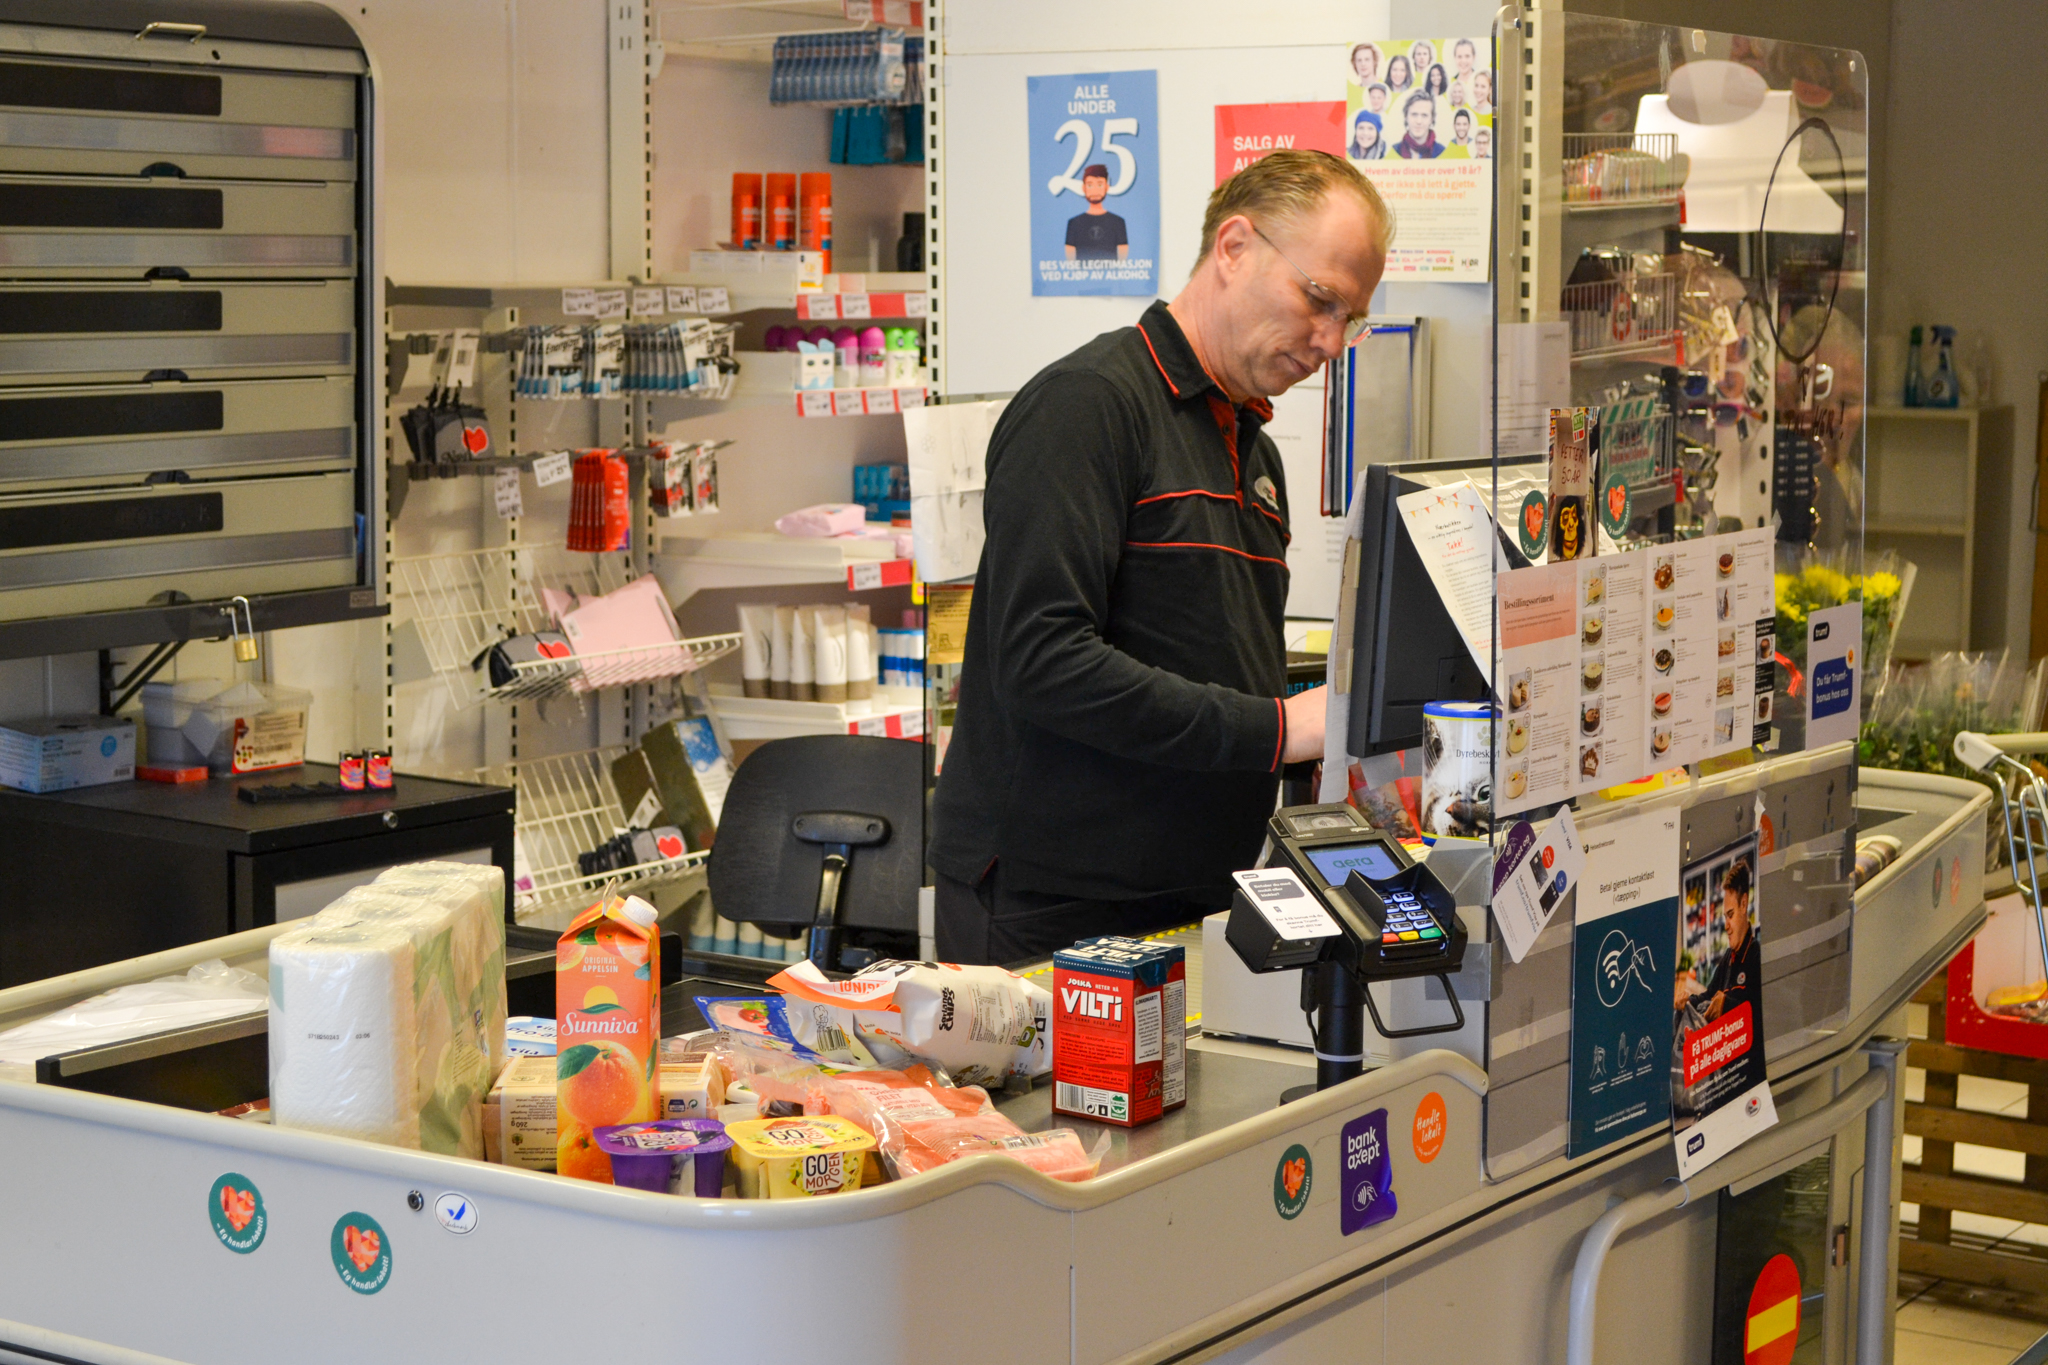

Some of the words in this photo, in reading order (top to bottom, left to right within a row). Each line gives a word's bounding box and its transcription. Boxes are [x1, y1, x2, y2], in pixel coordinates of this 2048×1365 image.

[1074, 85, 1109, 100] ALLE
[1068, 100, 1116, 115] UNDER
[1233, 135, 1272, 151] SALG
[1275, 135, 1295, 149] AV
[1048, 117, 1139, 198] 25
[1365, 167, 1389, 176] Hvem
[1403, 166, 1425, 175] disse
[1427, 167, 1435, 175] er
[1437, 167, 1455, 175] over
[1458, 166, 1467, 175] 18
[1469, 165, 1481, 174] år?
[1396, 179, 1414, 188] ikke
[1416, 179, 1426, 188] så
[1428, 179, 1442, 188] lett
[1444, 179, 1450, 188] å
[1451, 180, 1477, 190] gjette.
[1381, 190, 1408, 199] Derfor
[1410, 189, 1422, 199] må
[1424, 189, 1435, 199] du
[1437, 191, 1467, 201] spørre!
[1040, 261, 1057, 270] BES
[1060, 260, 1081, 270] VISE
[1083, 259, 1153, 270] LEGITIMASJON
[1041, 271, 1061, 281] VED
[1063, 270, 1088, 281] KJØP
[1090, 270, 1104, 280] AV
[1106, 270, 1150, 280] ALKOHOL
[1816, 677, 1824, 687] Du
[1824, 674, 1832, 685] får
[1832, 671, 1848, 684] Trumf-
[1816, 692, 1831, 704] bonus
[1831, 689, 1840, 700] hos
[1841, 688, 1849, 698] oss
[1332, 855, 1374, 869] aera
[1600, 881, 1612, 893] Betal
[1613, 879, 1627, 892] gjerne
[1628, 871, 1655, 885] kontaktløst
[582, 964, 619, 973] APPELSIN
[584, 956, 616, 965] ORIGINAL
[1067, 978, 1092, 989] JOIKA
[944, 989, 955, 1031] CHIPS
[561, 1012, 639, 1036] Sunniva
[1692, 1037, 1701, 1057] Få
[1700, 1017, 1744, 1048] TRUMF-bonus
[1690, 1058, 1699, 1080] på
[1699, 1053, 1712, 1070] alle
[1711, 1032, 1748, 1064] dagligvarer
[1417, 1109, 1440, 1131] Handle
[768, 1128, 805, 1140] GO
[1348, 1126, 1377, 1153] bank
[1421, 1121, 1441, 1144] lokalt
[1347, 1141, 1380, 1170] axept
[805, 1154, 828, 1177] GO
[805, 1151, 841, 1190] MORGEN
[1280, 1201, 1286, 1214] Eg
[1285, 1202, 1302, 1215] handlar
[219, 1228, 228, 1240] Eg
[228, 1236, 253, 1248] handlar
[252, 1216, 264, 1243] lokalt!
[342, 1269, 352, 1281] Eg
[351, 1278, 378, 1290] handlar
[376, 1255, 389, 1284] lokalt!
